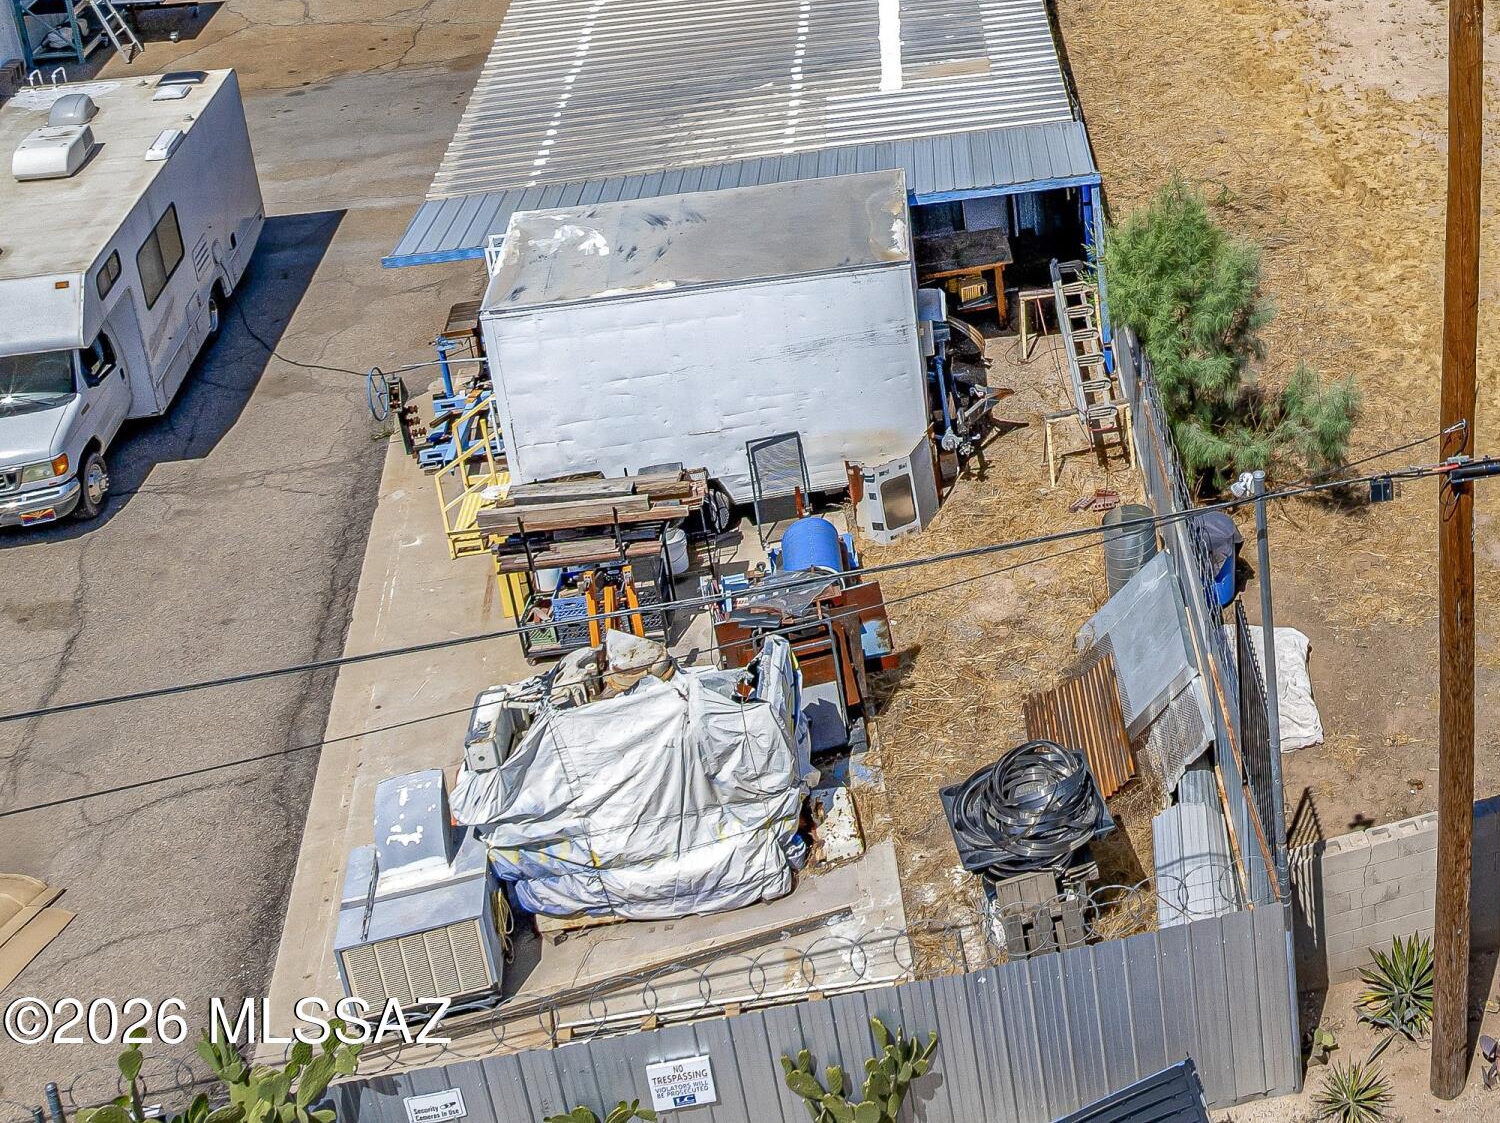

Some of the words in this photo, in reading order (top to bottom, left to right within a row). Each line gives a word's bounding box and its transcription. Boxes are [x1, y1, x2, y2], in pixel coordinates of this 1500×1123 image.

[673, 1064, 684, 1074] NO
[652, 1069, 708, 1085] TRESPASSING
[655, 1082, 692, 1094] VIOLATORS
[693, 1080, 709, 1088] WILL
[667, 1086, 709, 1097] PROSECUTED
[413, 1106, 439, 1115] Security
[415, 1113, 441, 1122] Cameras
